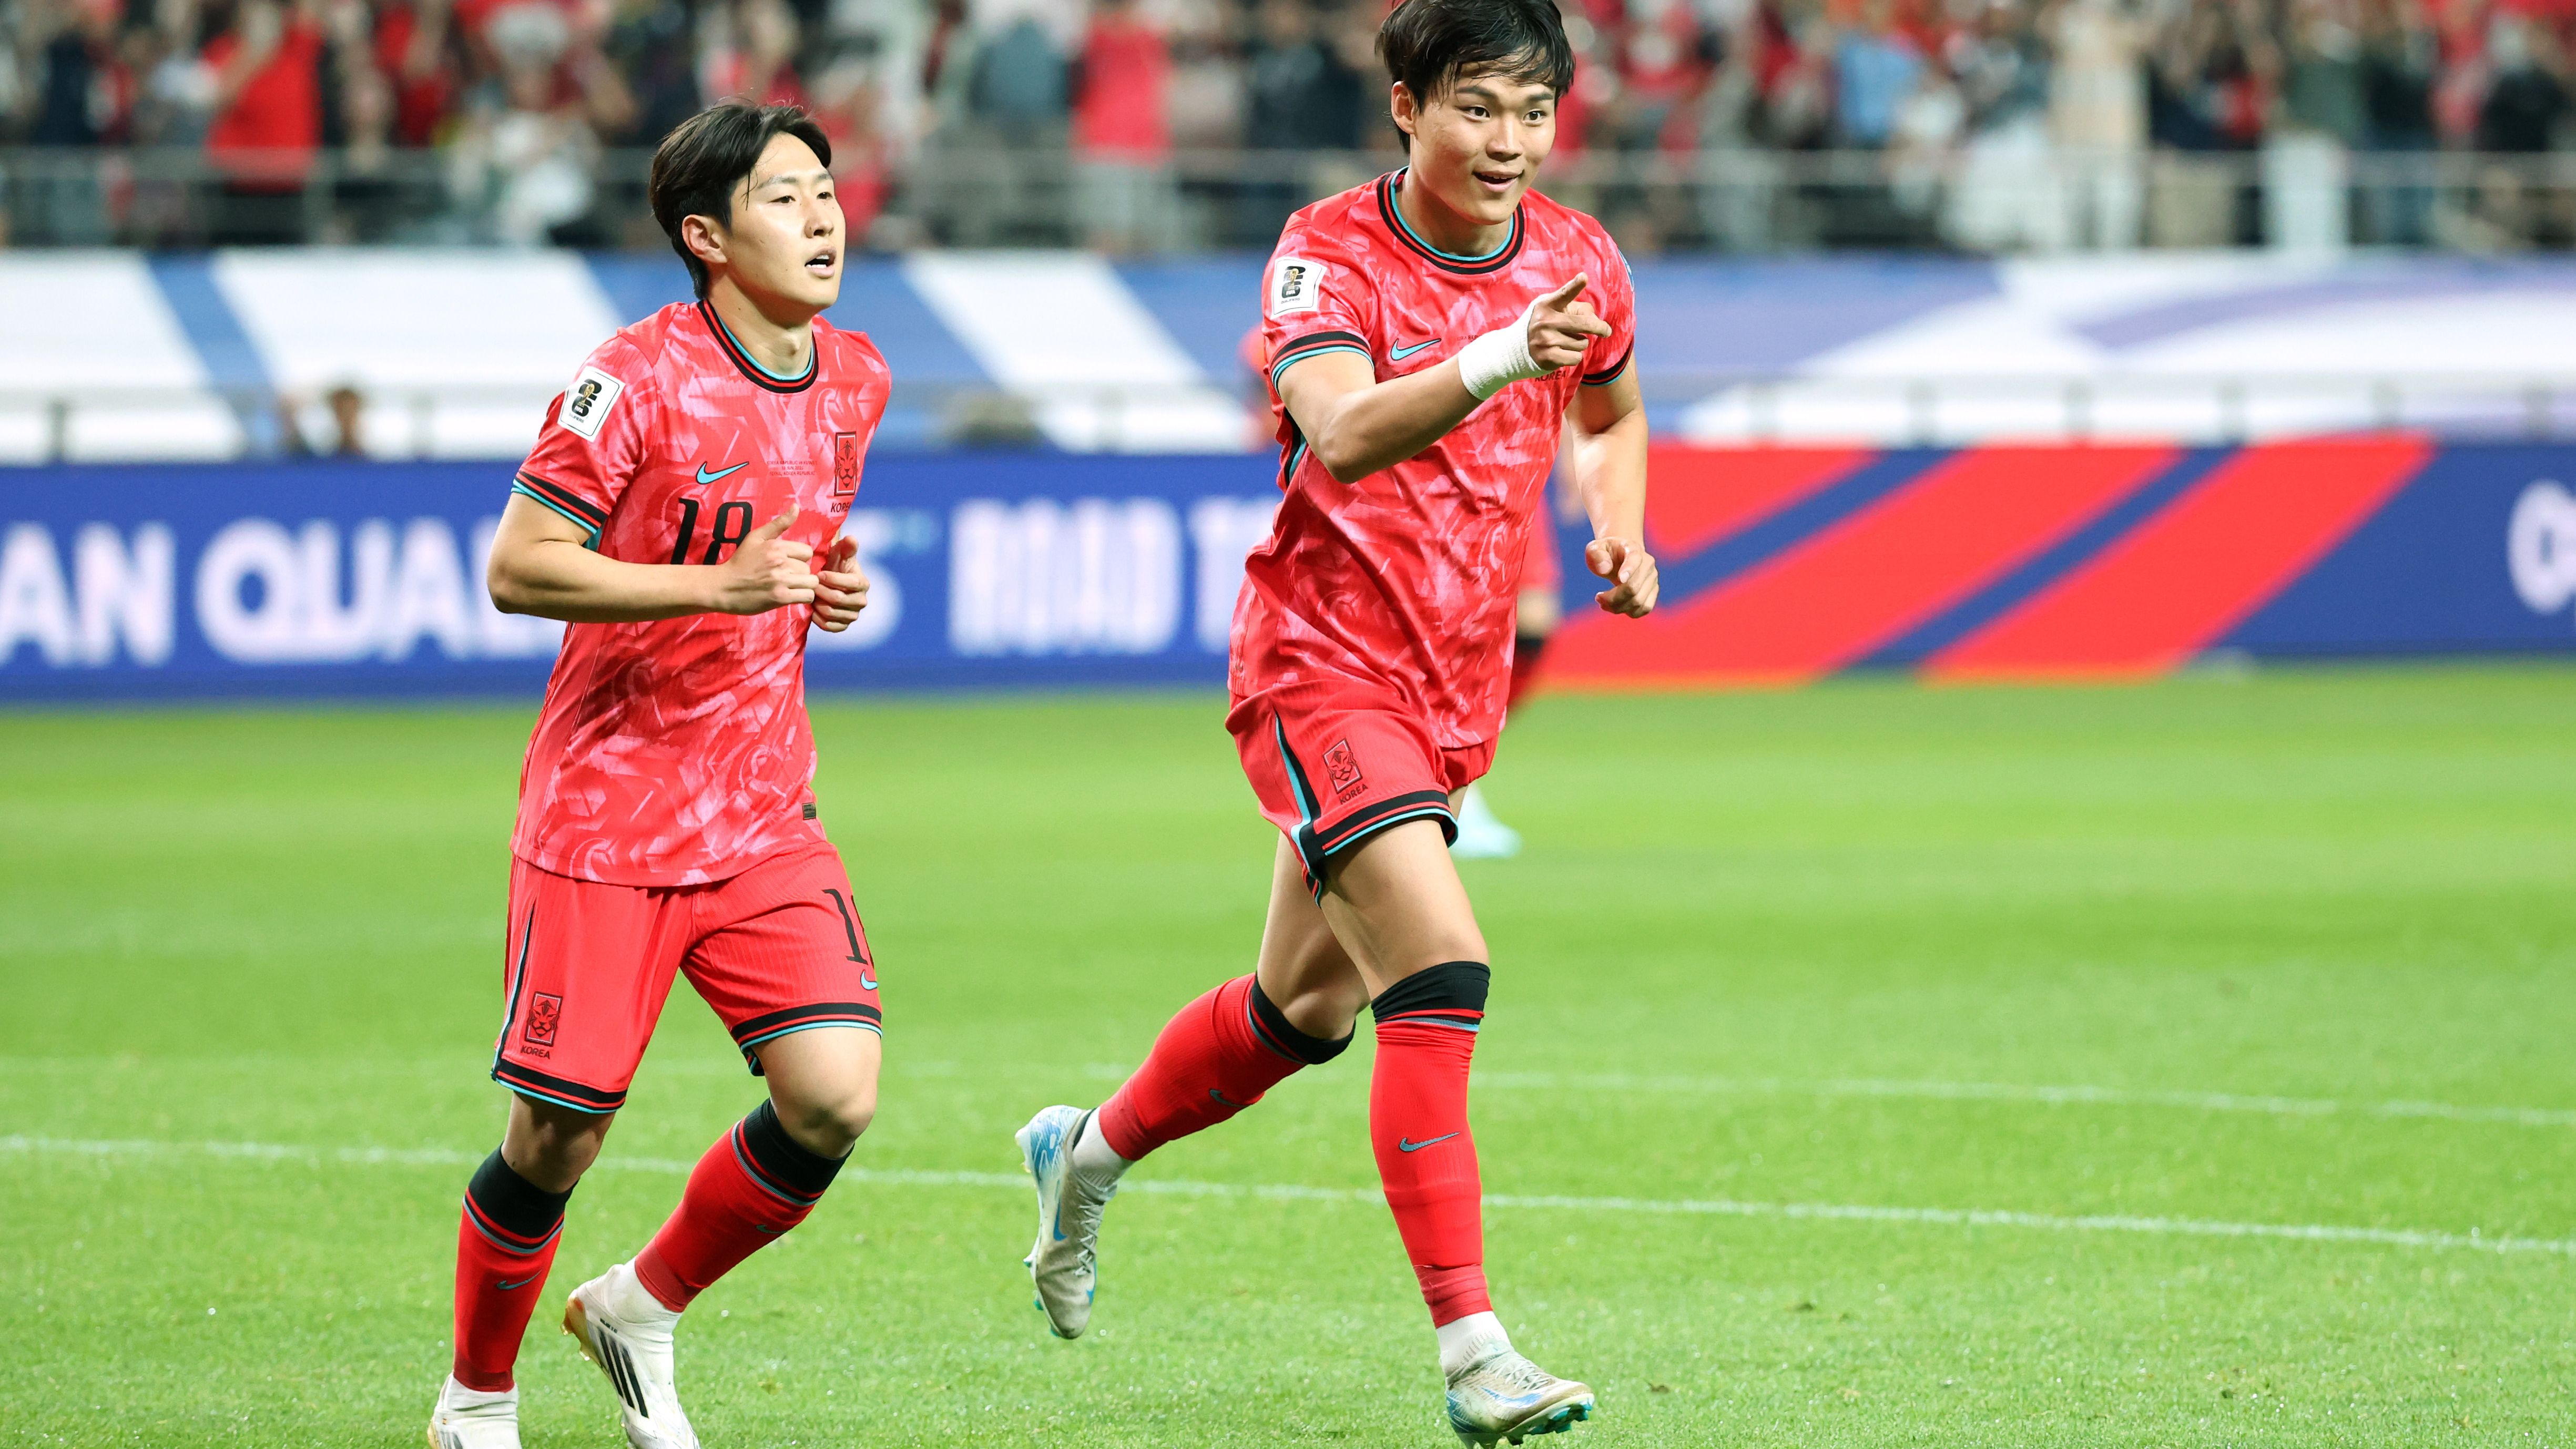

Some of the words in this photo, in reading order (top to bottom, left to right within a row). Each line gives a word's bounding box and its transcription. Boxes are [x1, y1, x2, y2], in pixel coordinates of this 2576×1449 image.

[670, 497, 753, 565] 18
[1339, 783, 1368, 805] KOREA
[821, 889, 874, 970] 1
[521, 1045, 551, 1060] KOREA
